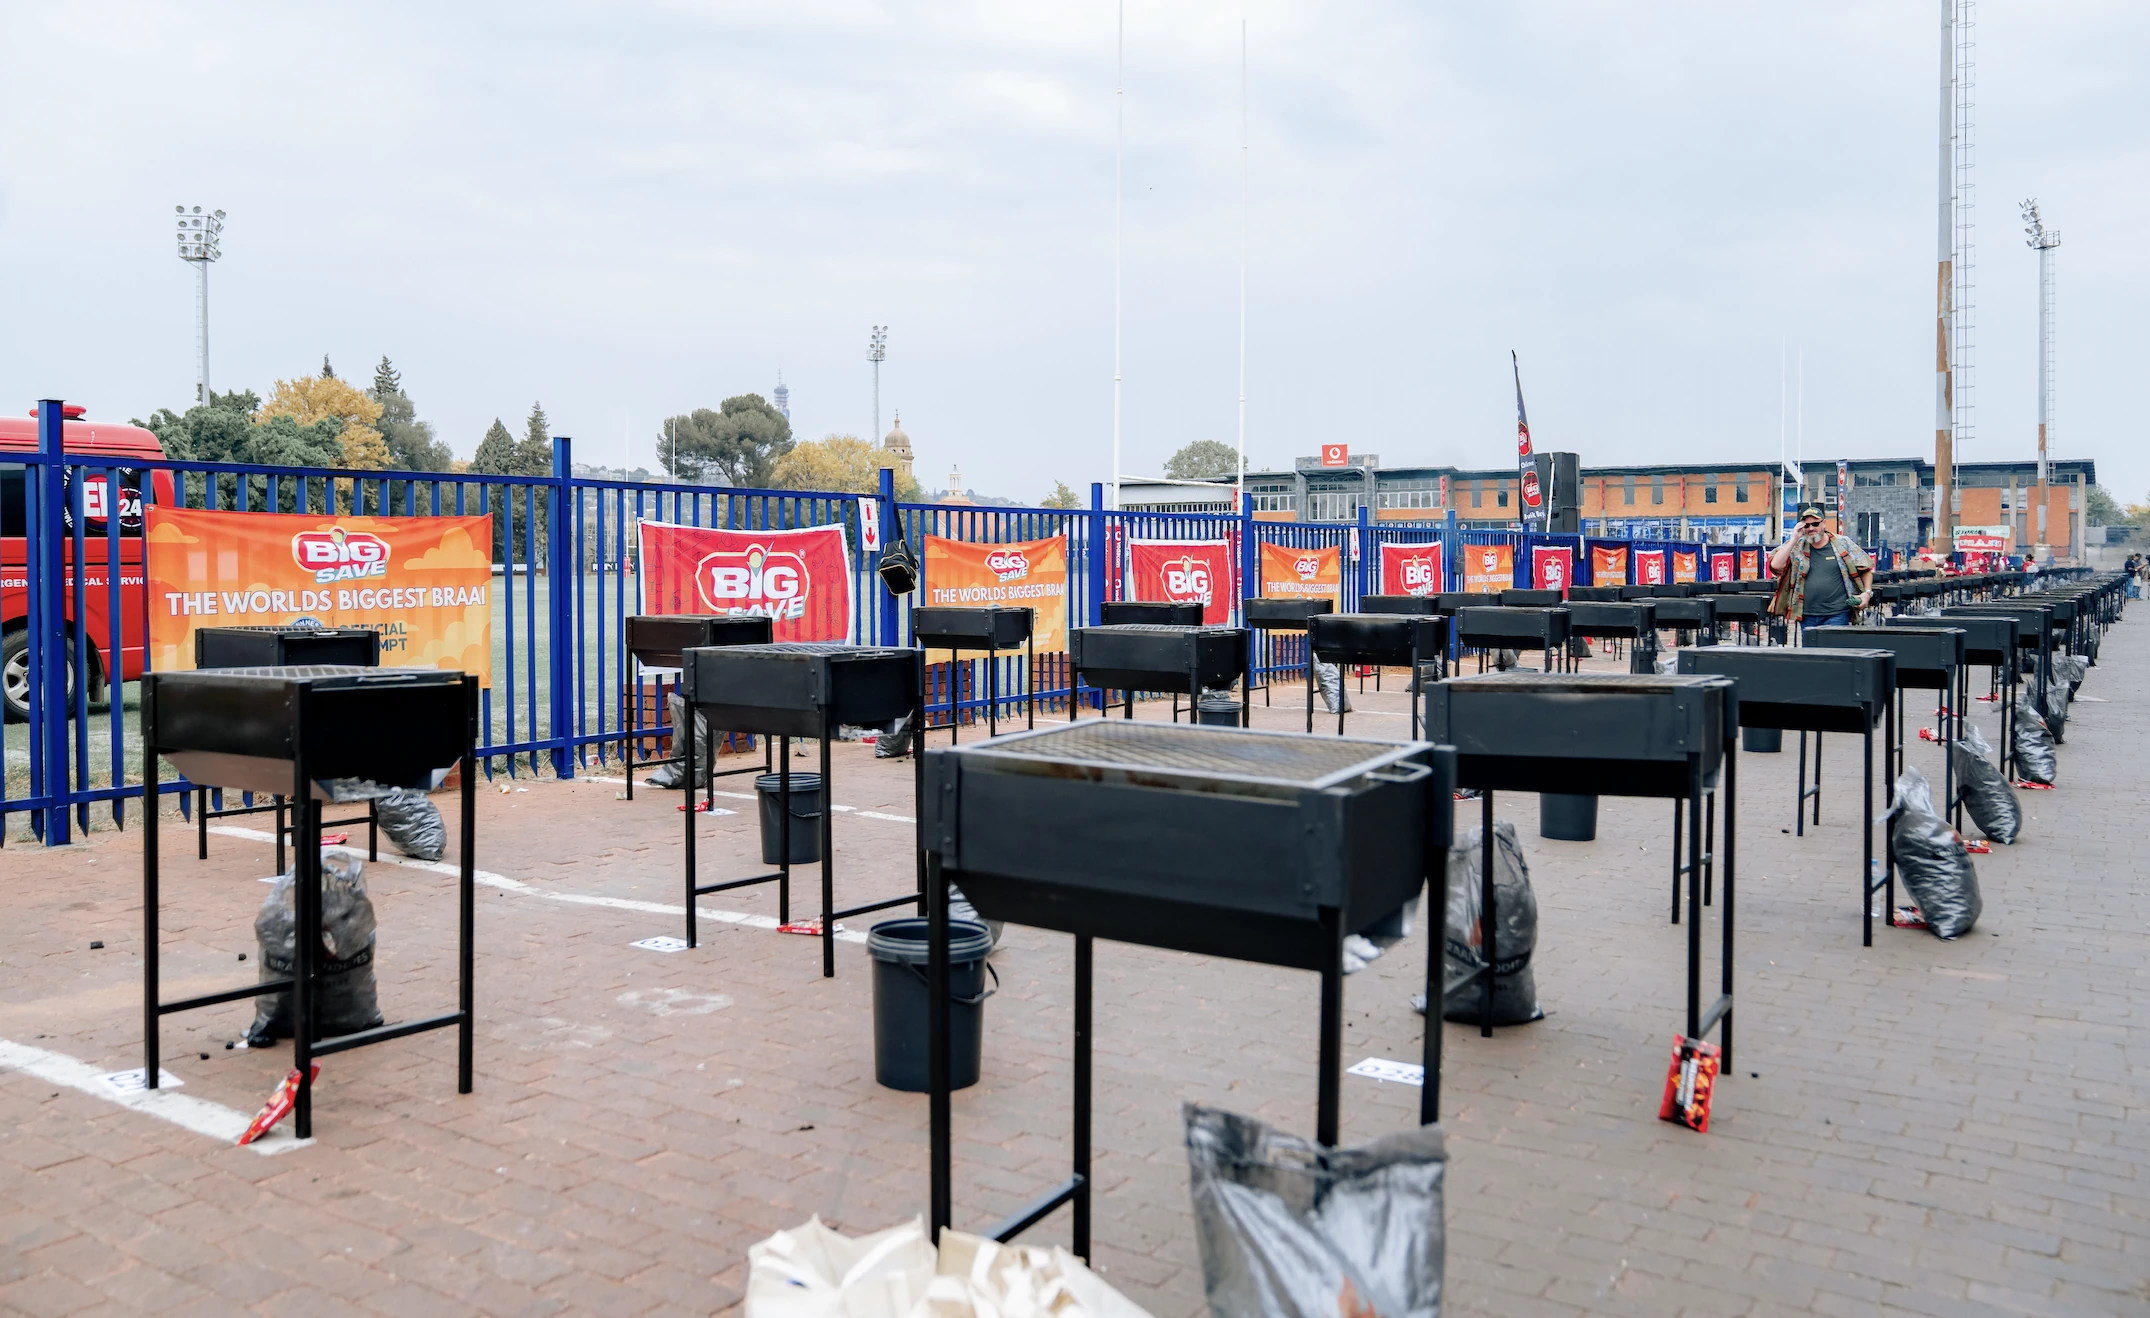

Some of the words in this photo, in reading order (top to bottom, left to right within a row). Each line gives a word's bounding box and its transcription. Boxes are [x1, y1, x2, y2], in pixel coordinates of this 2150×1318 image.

[303, 539, 381, 562] BIG
[315, 560, 386, 583] SAVE
[990, 555, 1026, 569] BIG
[1297, 559, 1318, 572] BIG
[711, 564, 799, 599] BIG
[999, 567, 1028, 583] SAVE
[1167, 570, 1208, 594] BIG
[1405, 564, 1433, 585] BIG
[933, 588, 957, 604] THE
[958, 586, 1006, 602] WORLDS
[1008, 584, 1046, 600] BIGGEST
[1267, 581, 1280, 593] THE
[165, 591, 218, 616] THE
[221, 589, 333, 614] WORLDS
[339, 587, 427, 610] BIGGEST
[432, 585, 486, 608] BRAAI
